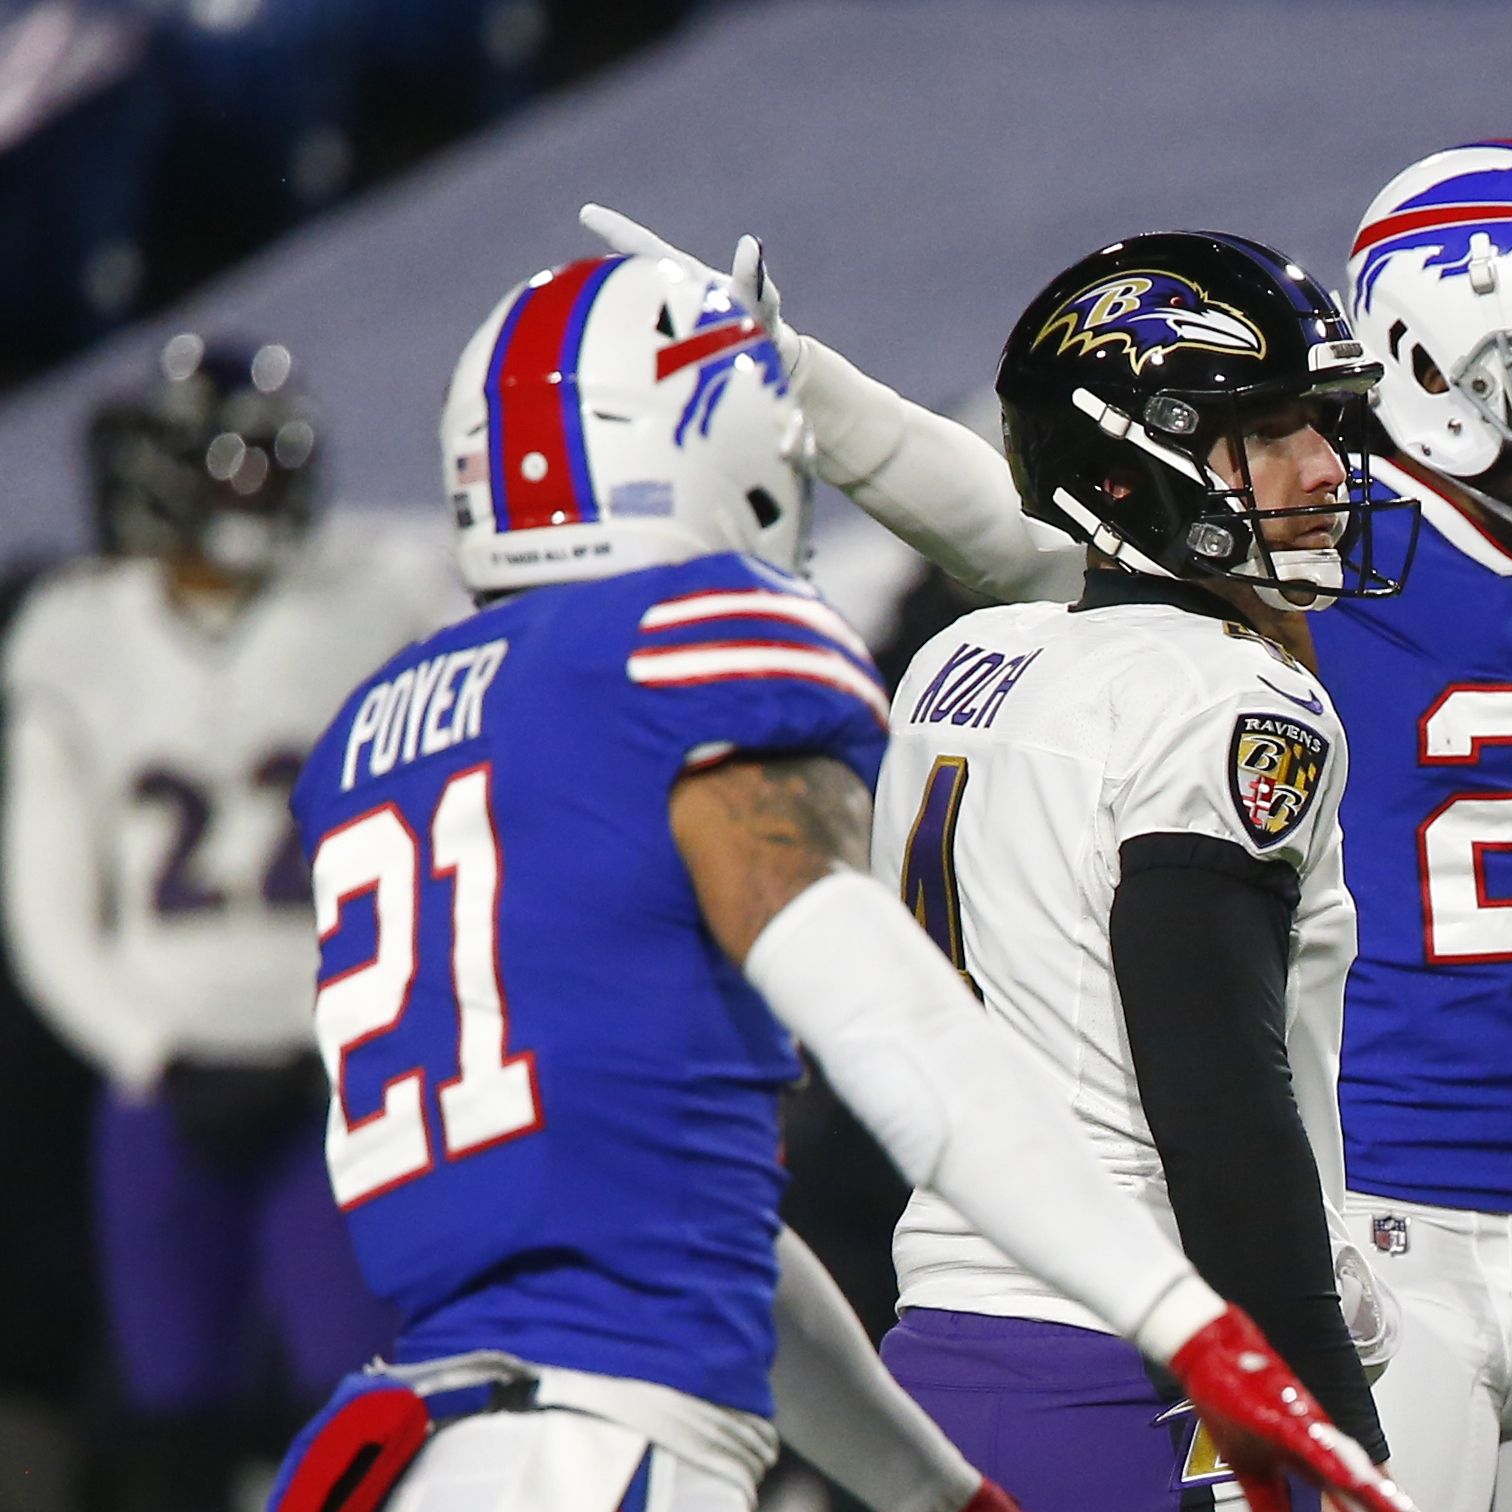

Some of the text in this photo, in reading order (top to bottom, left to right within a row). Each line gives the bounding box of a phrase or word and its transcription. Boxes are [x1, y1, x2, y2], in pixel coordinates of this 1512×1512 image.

[340, 638, 507, 792] POYER
[910, 643, 1044, 729] KOCH
[1244, 718, 1322, 753] RAVENS
[312, 761, 545, 1213] 21
